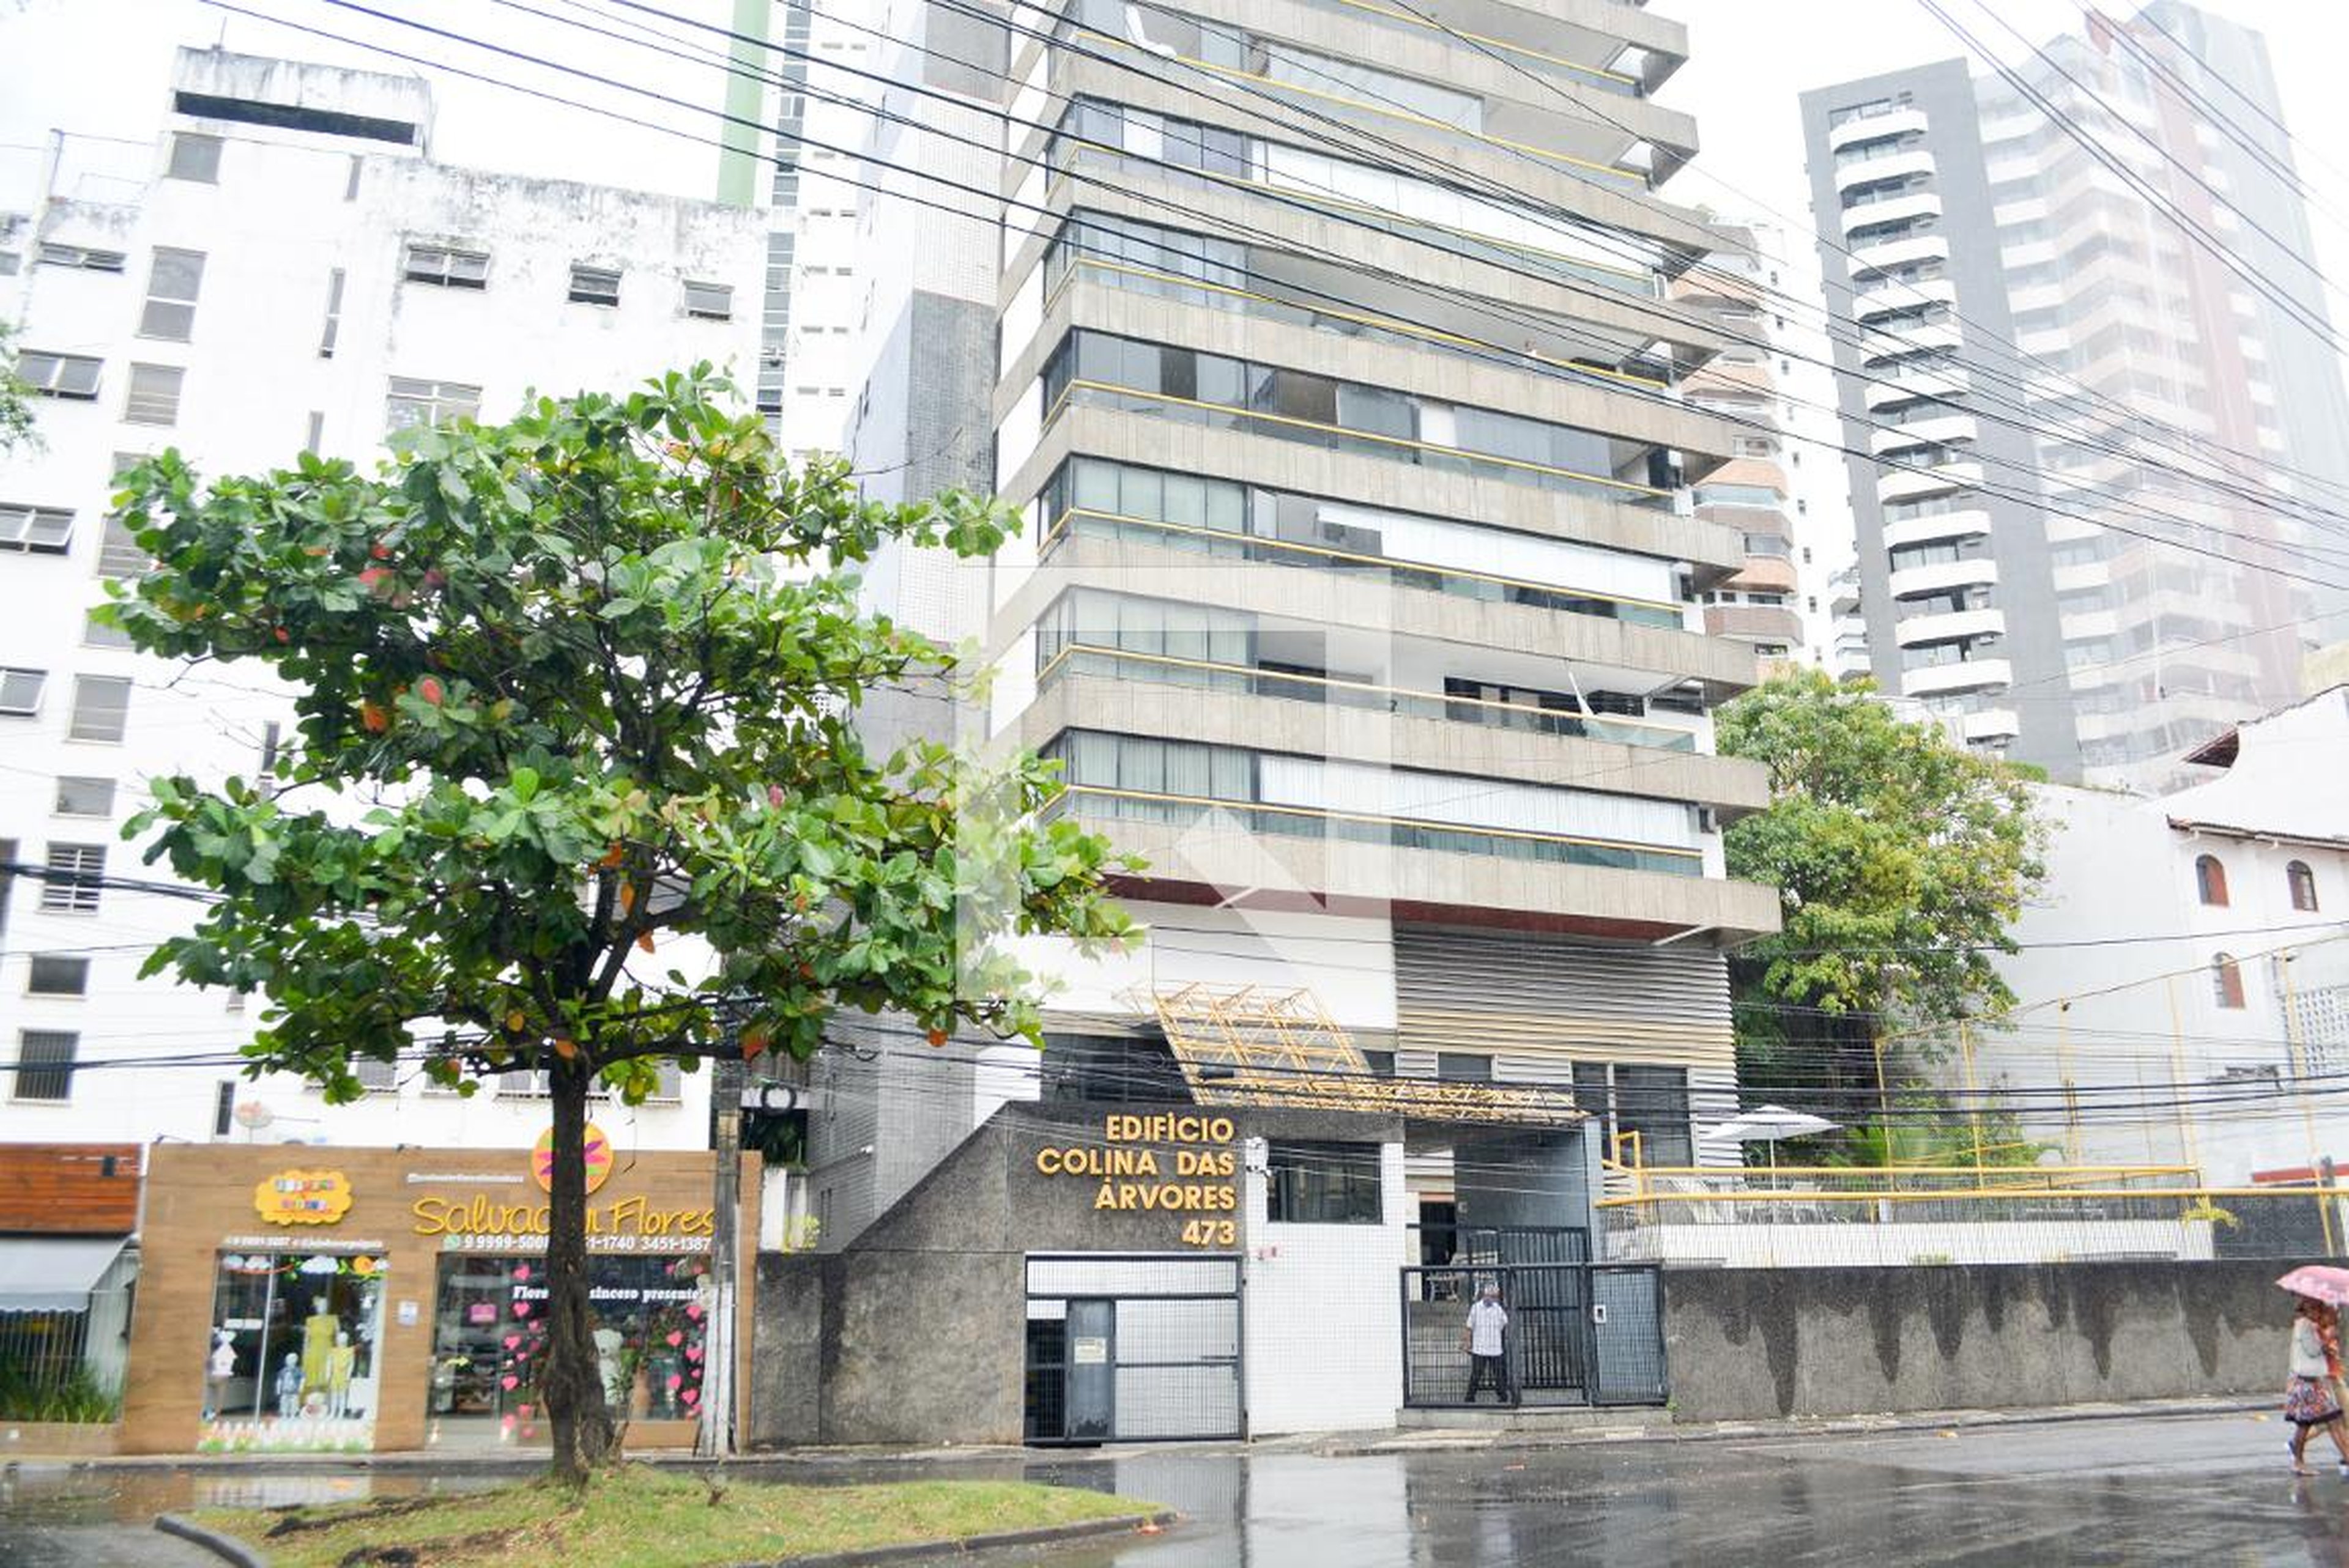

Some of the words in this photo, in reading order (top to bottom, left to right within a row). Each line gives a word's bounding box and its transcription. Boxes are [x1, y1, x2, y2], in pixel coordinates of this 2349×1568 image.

[1106, 1111, 1234, 1144] EDIFÍCIO
[1037, 1147, 1158, 1175] COLINA
[1177, 1150, 1234, 1175] DAS
[1094, 1176, 1235, 1210] ÁRVORES
[608, 1194, 715, 1235] Flores
[1181, 1219, 1235, 1245] 473
[512, 1285, 549, 1300] Flore
[588, 1285, 639, 1300] sincero
